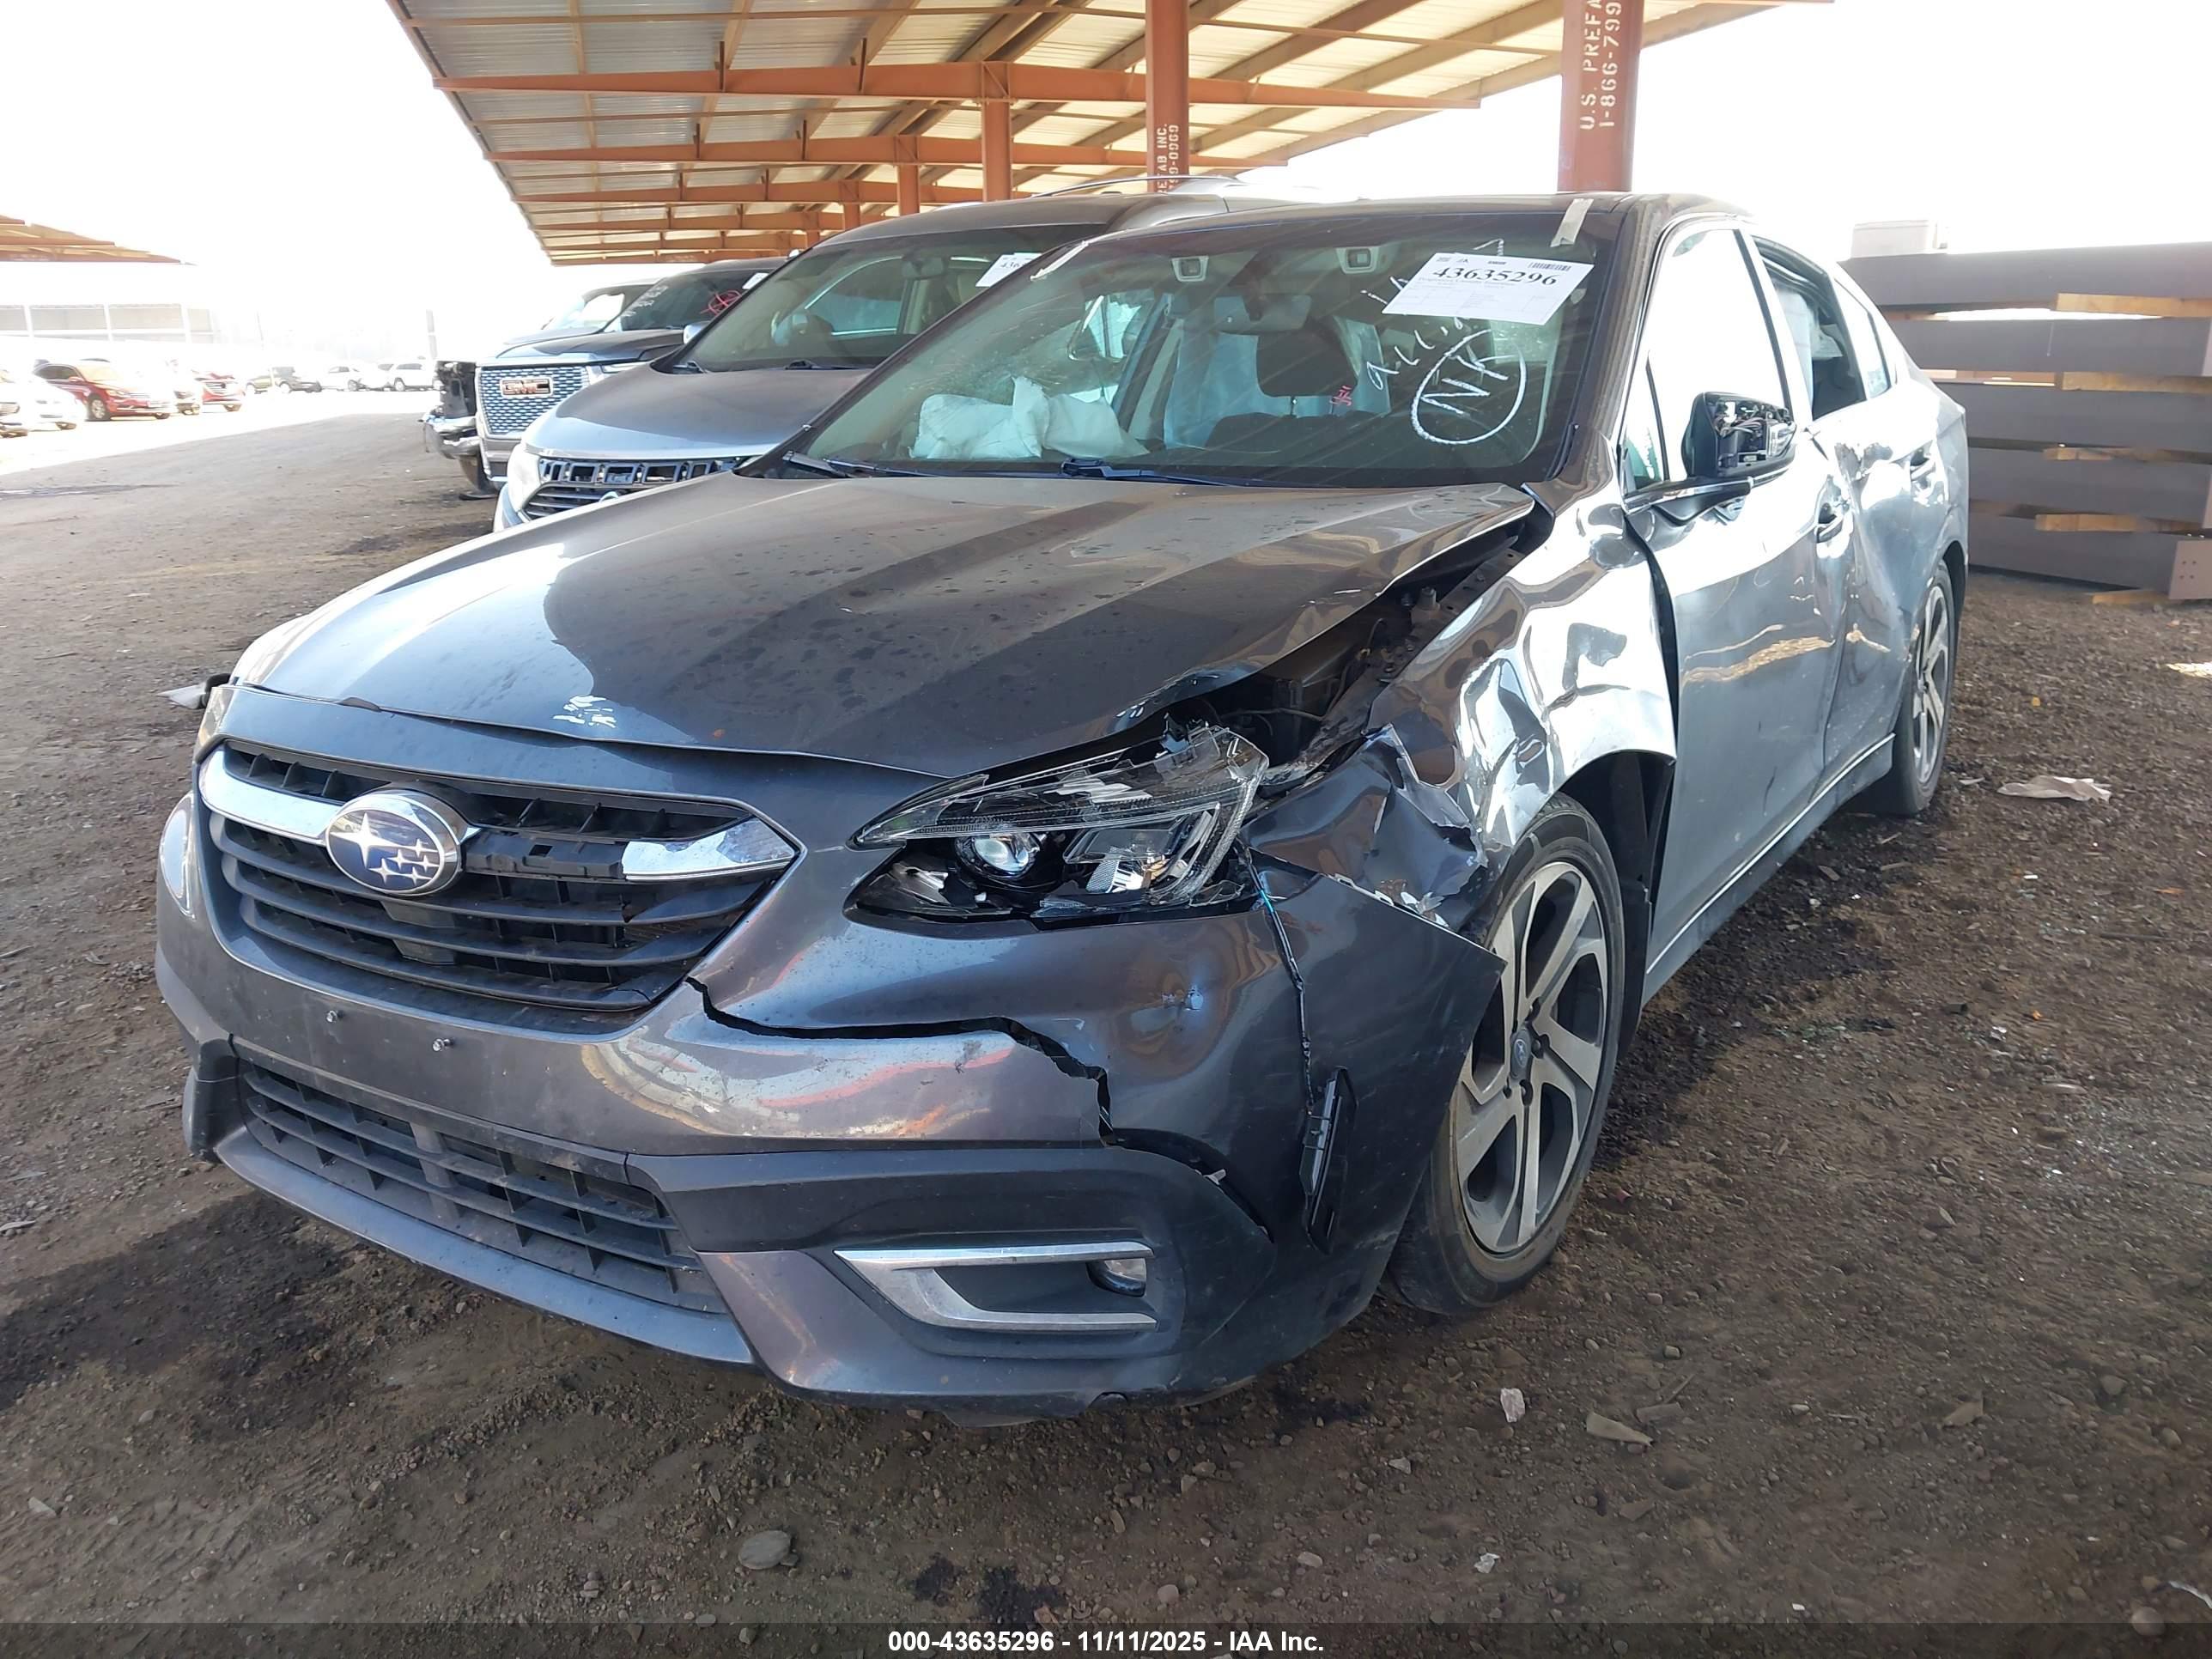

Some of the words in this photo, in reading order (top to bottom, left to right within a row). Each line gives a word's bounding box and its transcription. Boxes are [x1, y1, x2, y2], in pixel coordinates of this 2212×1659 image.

[1598, 2, 1622, 127] 1-866-799
[1579, 87, 1597, 130] U.S.
[1156, 124, 1168, 149] INC.
[1432, 266, 1560, 286] 43635296
